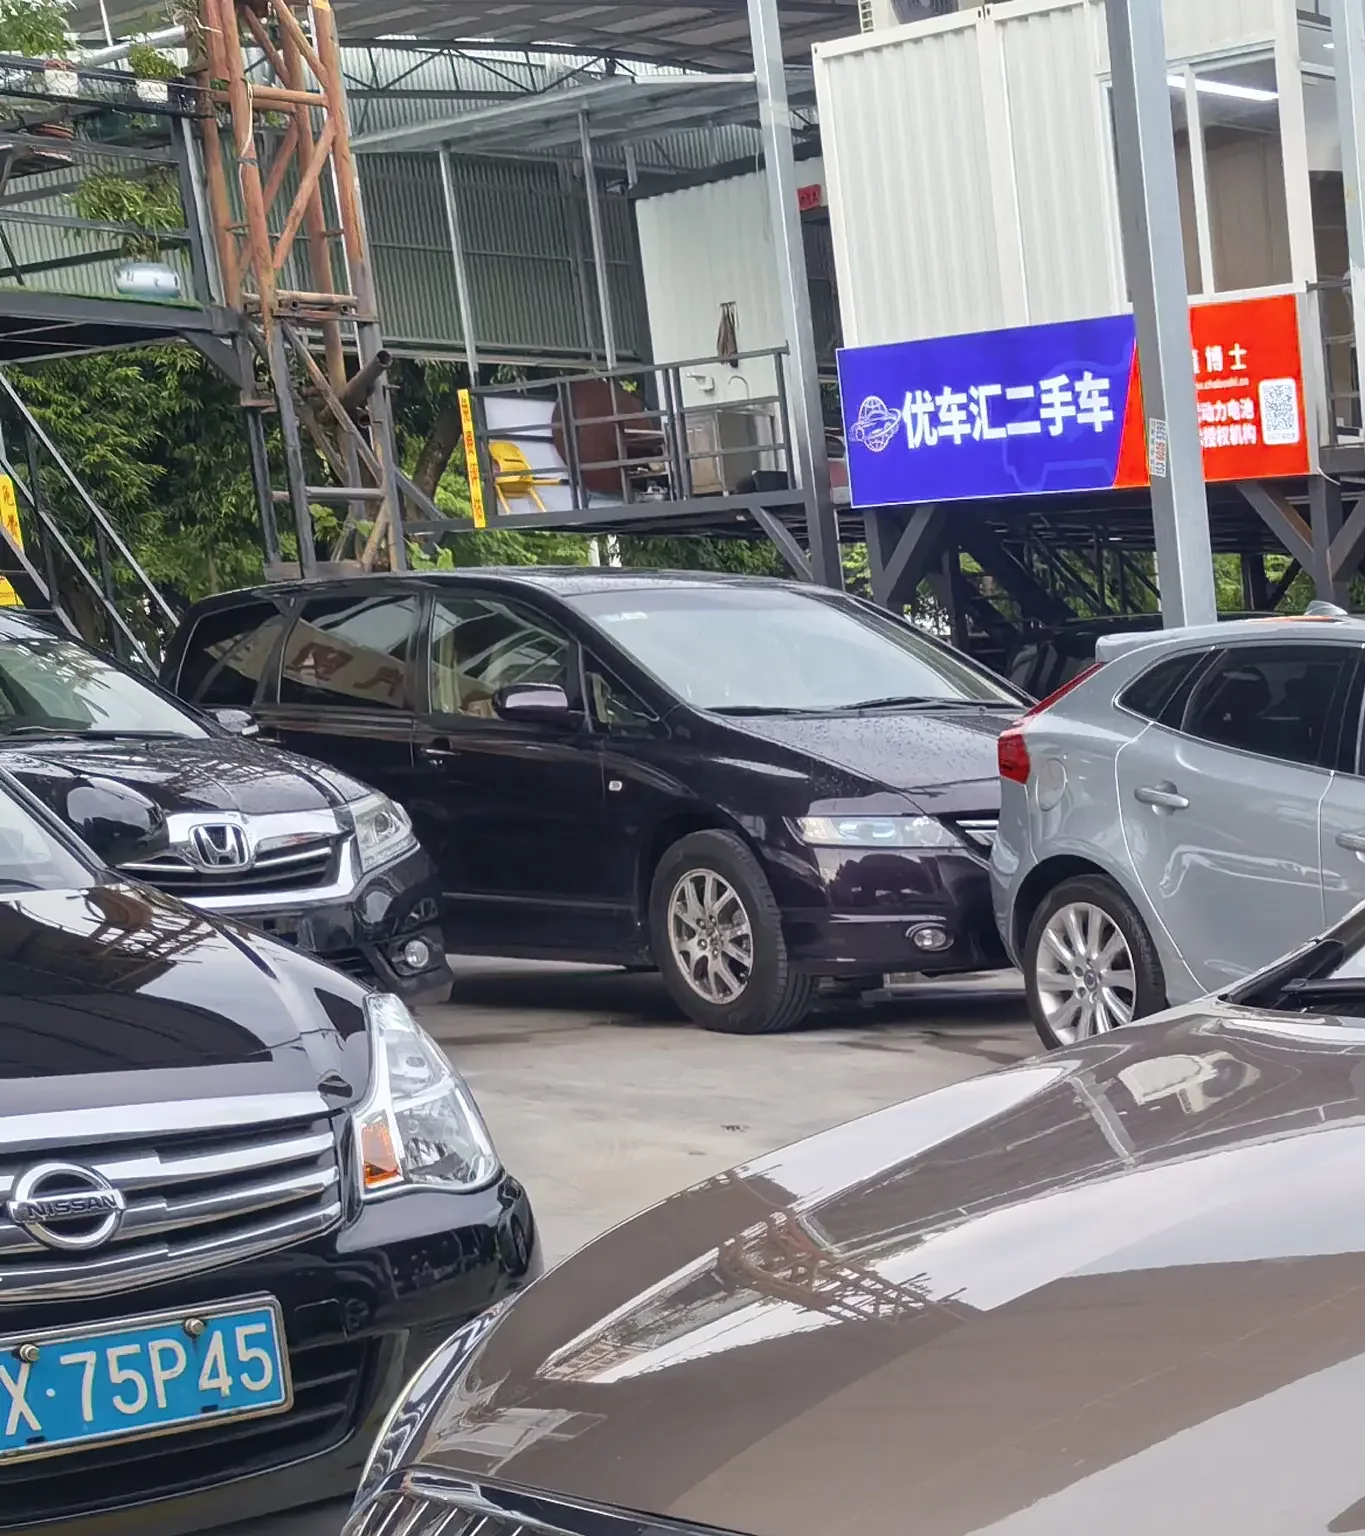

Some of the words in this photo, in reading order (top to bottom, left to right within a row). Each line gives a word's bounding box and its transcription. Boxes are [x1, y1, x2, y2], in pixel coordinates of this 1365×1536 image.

[902, 371, 1114, 450] 优车汇二手车
[27, 1194, 119, 1221] NISSAN
